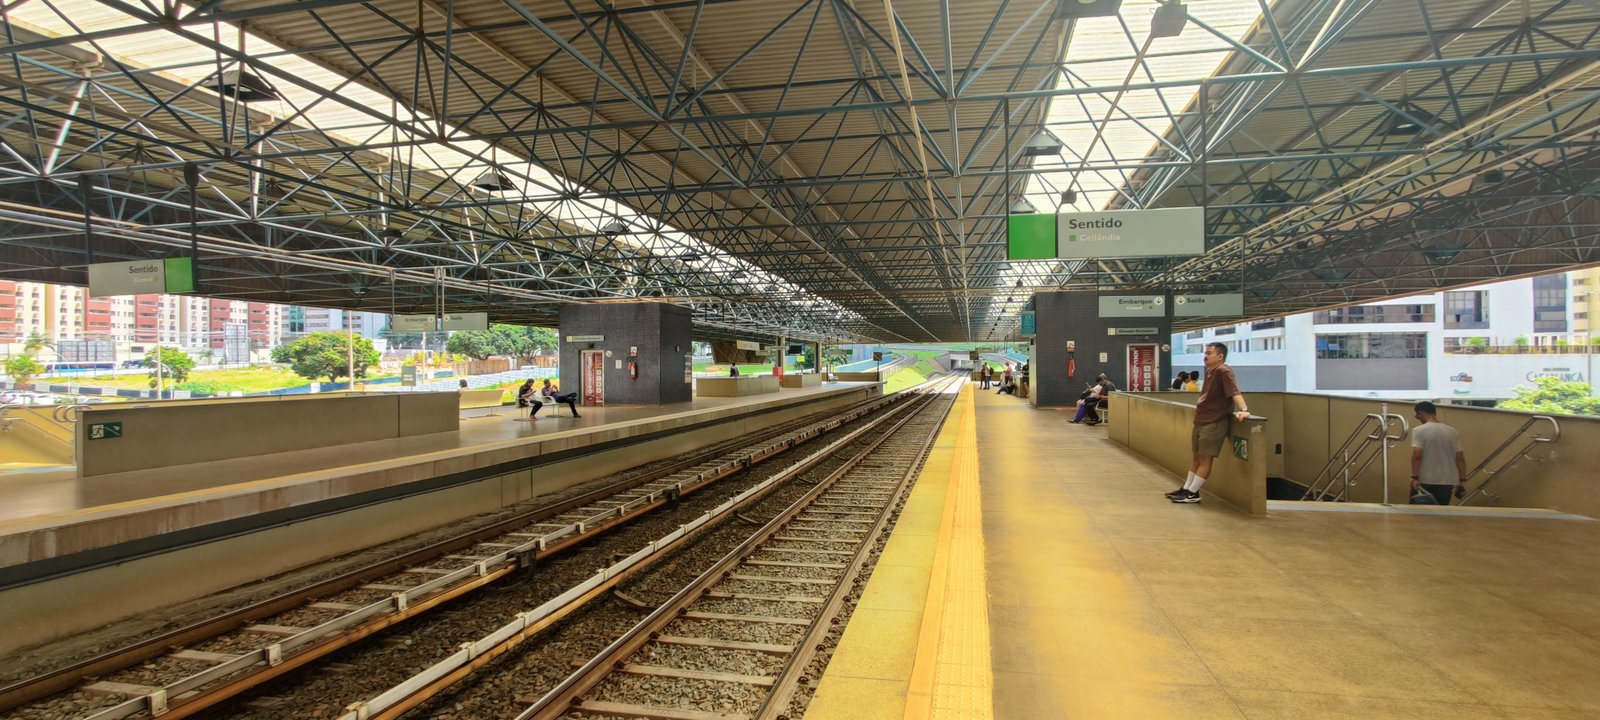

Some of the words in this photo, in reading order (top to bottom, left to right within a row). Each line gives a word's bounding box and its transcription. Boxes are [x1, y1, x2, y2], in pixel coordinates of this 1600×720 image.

[1069, 217, 1122, 229] Sentido
[1080, 233, 1120, 241] Ceilândia
[128, 265, 158, 273] Sentido
[1526, 371, 1584, 382] CASANCA
